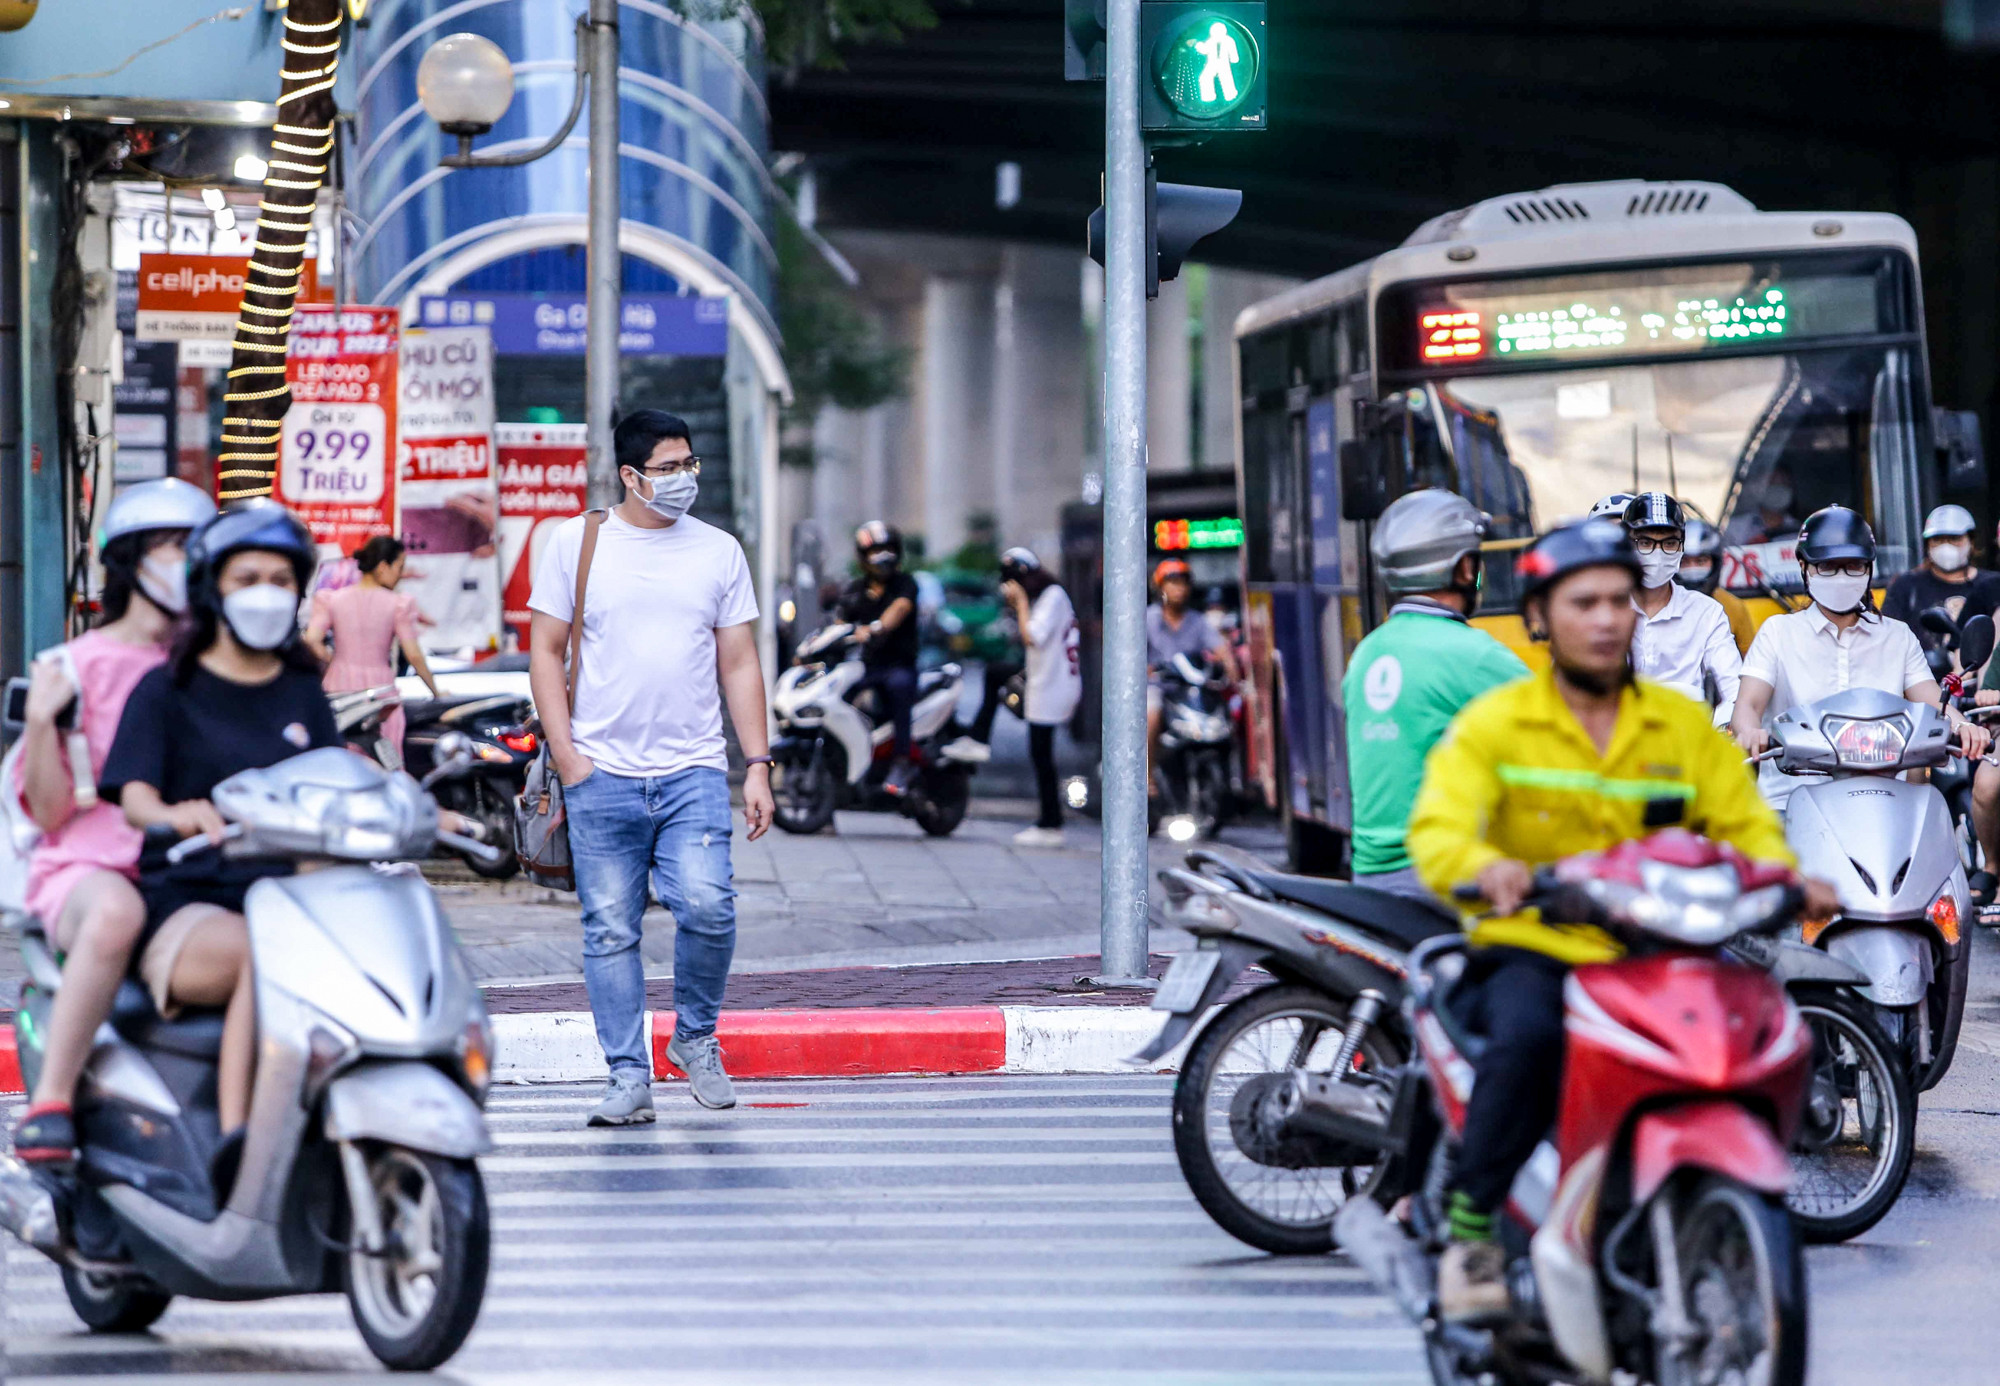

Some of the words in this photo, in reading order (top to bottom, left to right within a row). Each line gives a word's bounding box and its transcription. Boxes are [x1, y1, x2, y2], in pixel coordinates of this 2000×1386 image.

[146, 266, 245, 298] cellpho
[403, 343, 436, 366] HU
[297, 362, 371, 383] LENOVO
[366, 382, 380, 402] 3
[296, 430, 371, 460] 9.99
[299, 466, 368, 495] TRIỆU
